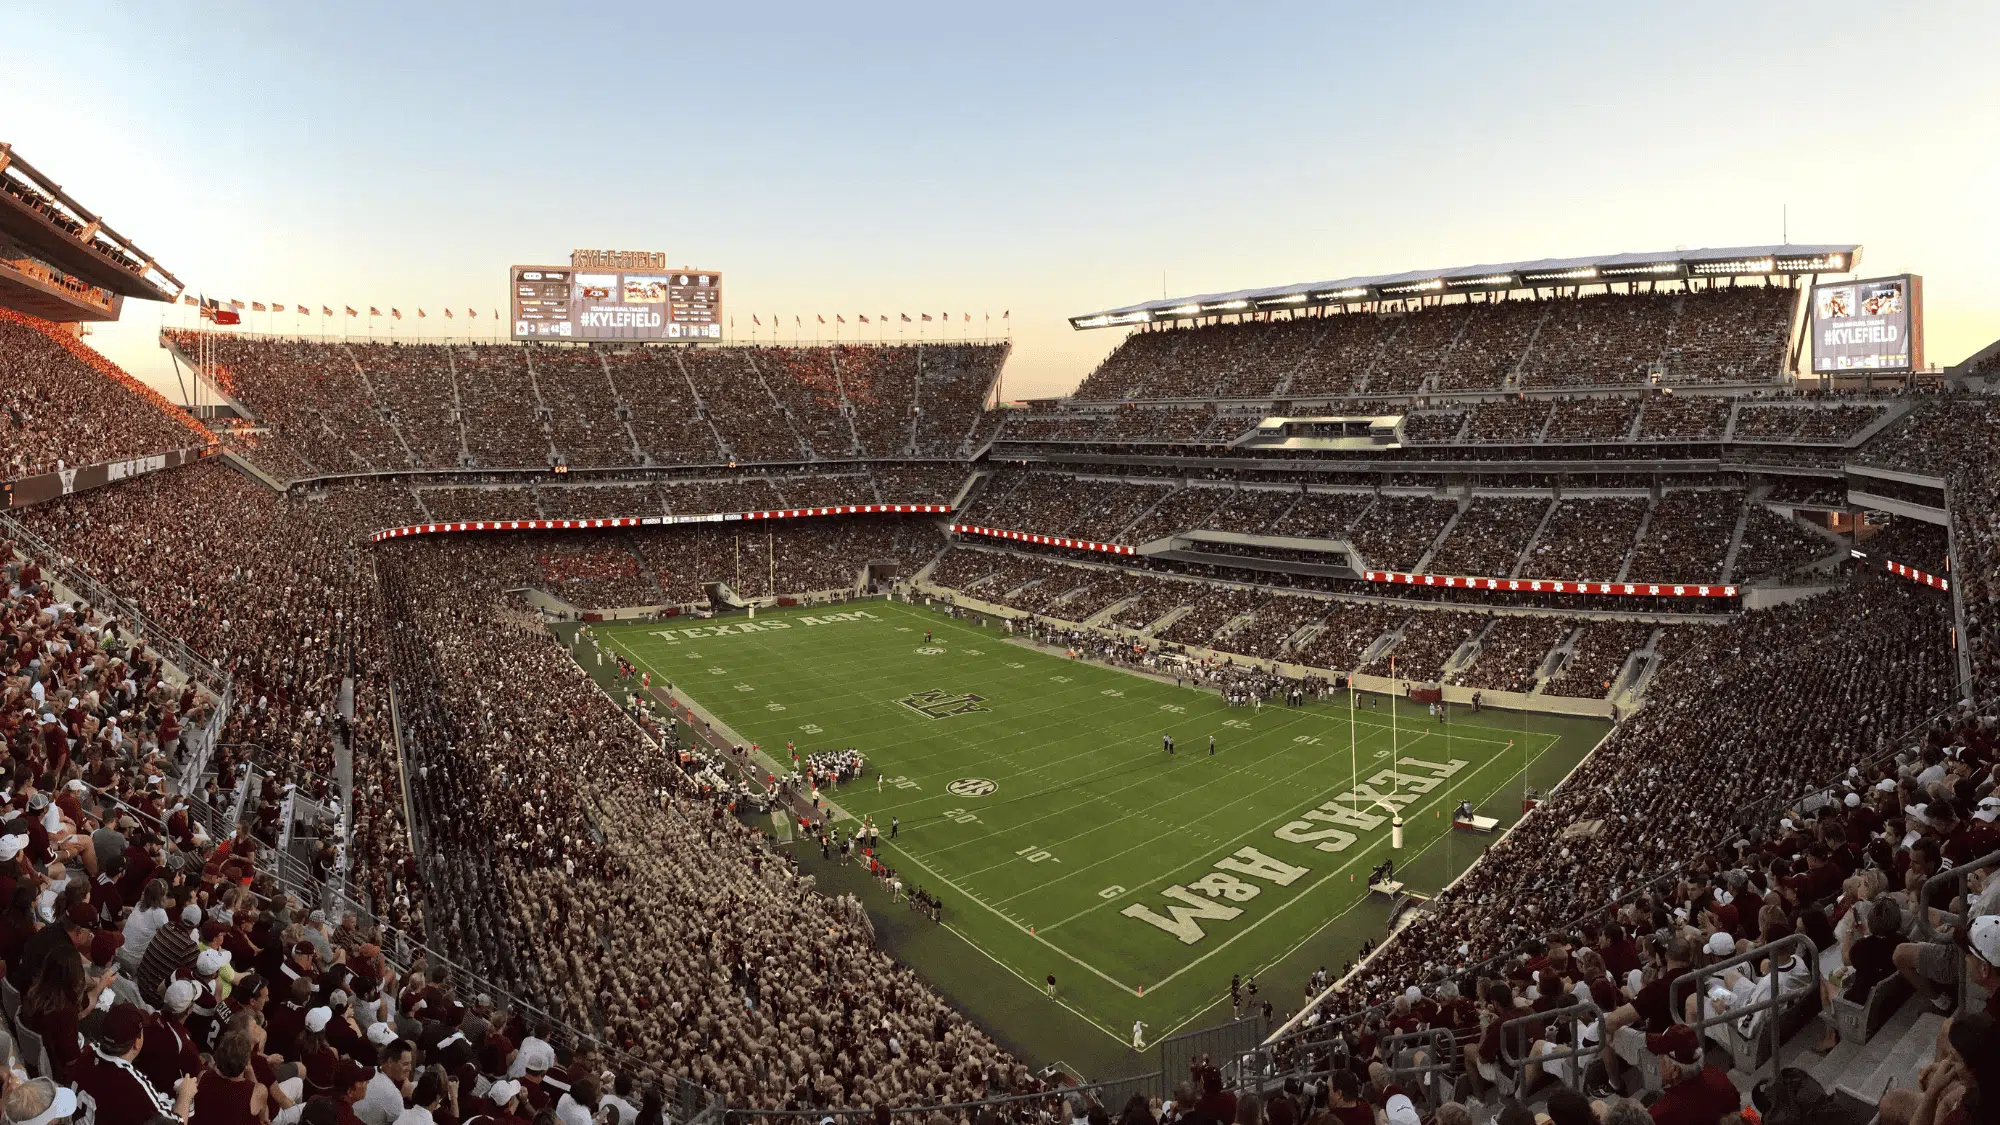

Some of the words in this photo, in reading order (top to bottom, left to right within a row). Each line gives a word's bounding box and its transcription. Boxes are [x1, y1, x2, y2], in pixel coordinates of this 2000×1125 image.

[573, 249, 616, 268] KYLE
[619, 251, 666, 270] FIELD
[580, 312, 661, 328] #KYLEFIELD
[1824, 325, 1897, 345] #KYLEFIELD
[649, 620, 792, 641] TEXAS
[796, 610, 879, 626] A&M
[798, 723, 824, 735] 50
[886, 775, 917, 789] 30
[1273, 757, 1470, 852] TEXAS
[942, 808, 978, 824] 20
[1015, 845, 1051, 863] 10
[1098, 884, 1126, 899] G
[1120, 845, 1311, 945] A&M
[207, 1019, 220, 1050] 2
